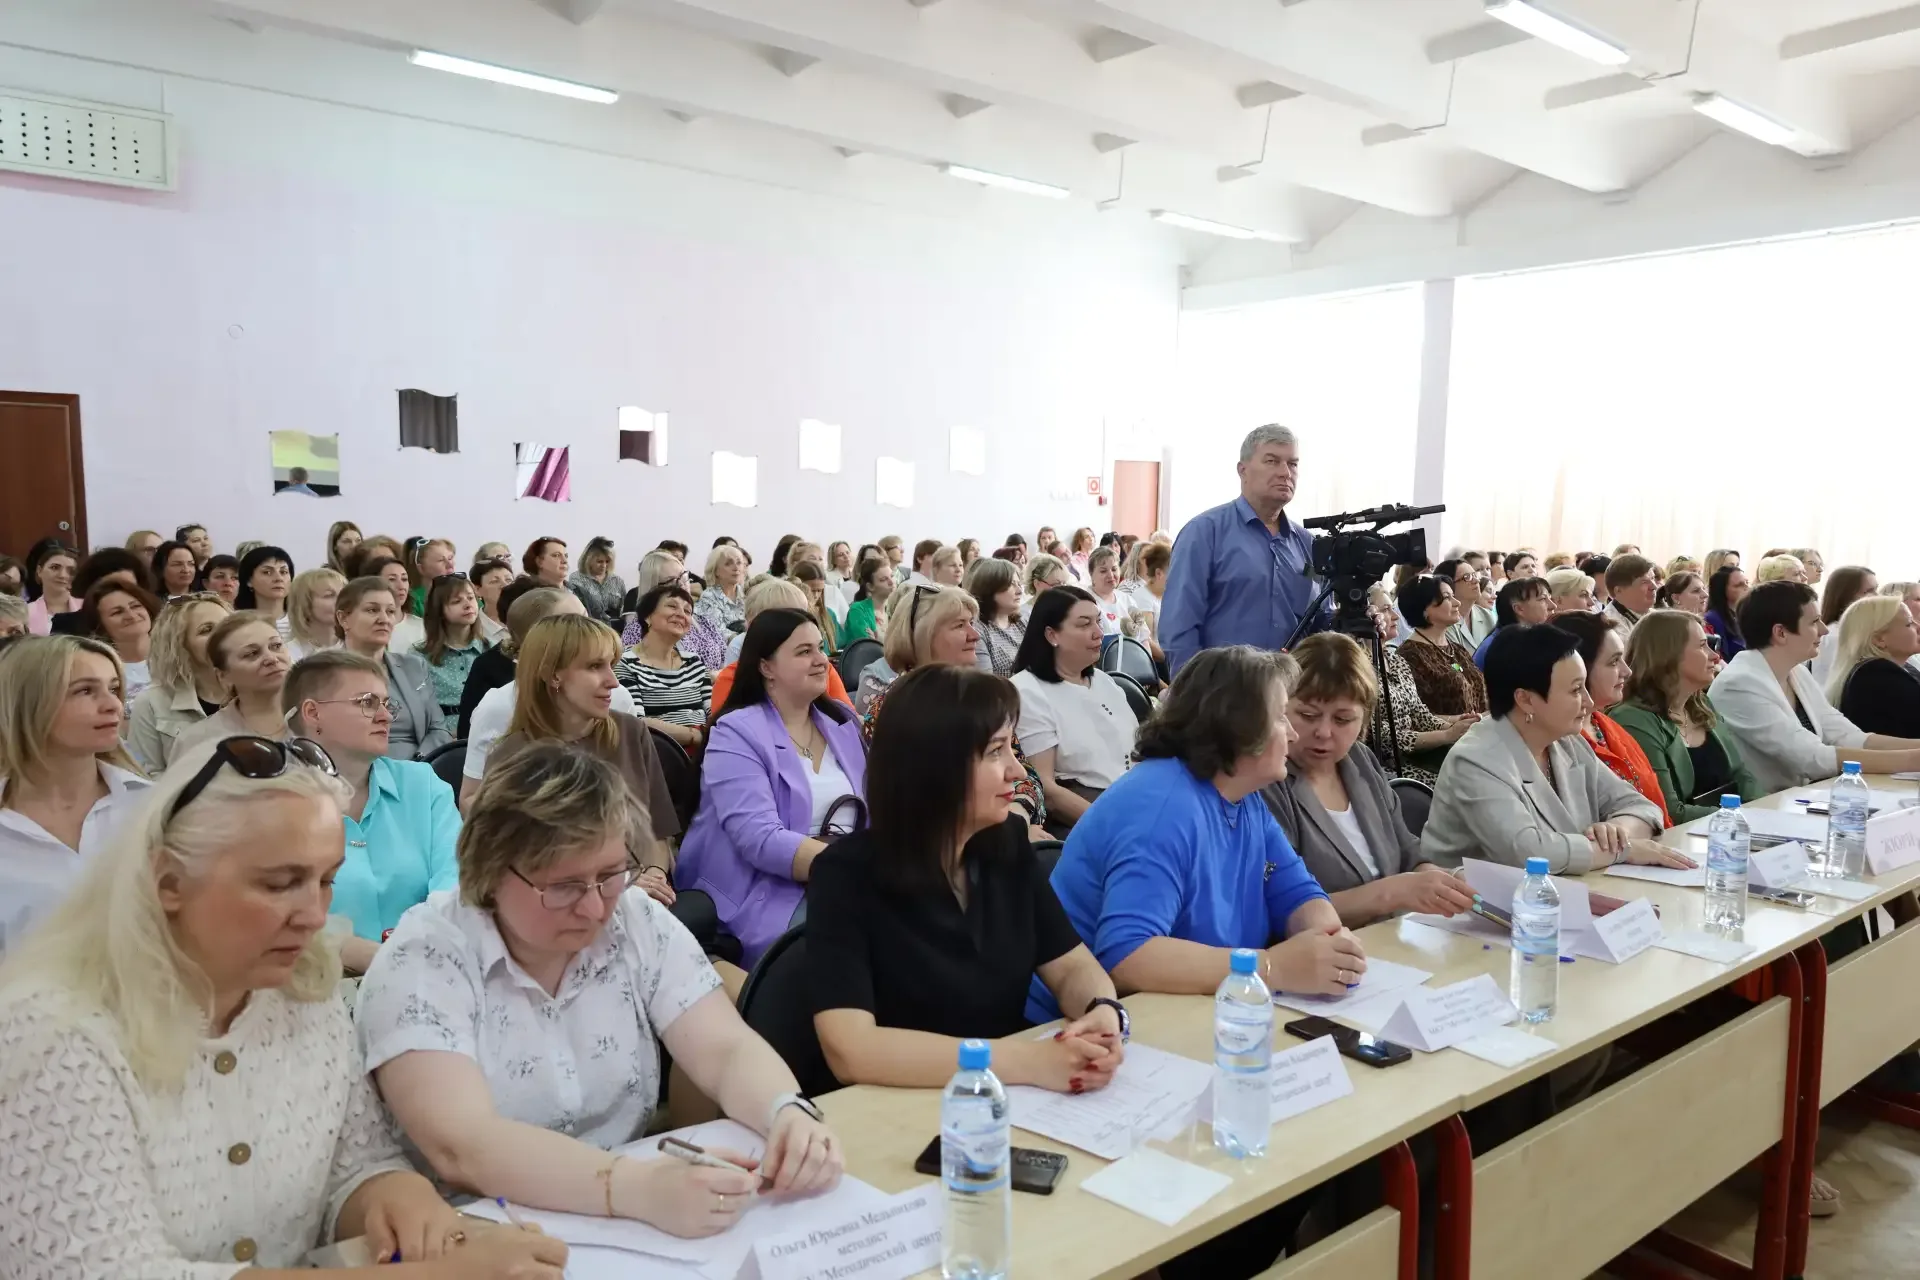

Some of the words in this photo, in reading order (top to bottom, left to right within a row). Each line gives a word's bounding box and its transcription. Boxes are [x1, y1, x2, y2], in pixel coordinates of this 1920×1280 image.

[770, 1239, 807, 1258] Ольга
[808, 1221, 860, 1246] Юрьевна
[860, 1197, 927, 1226] Мельникова
[837, 1231, 888, 1256] методист
